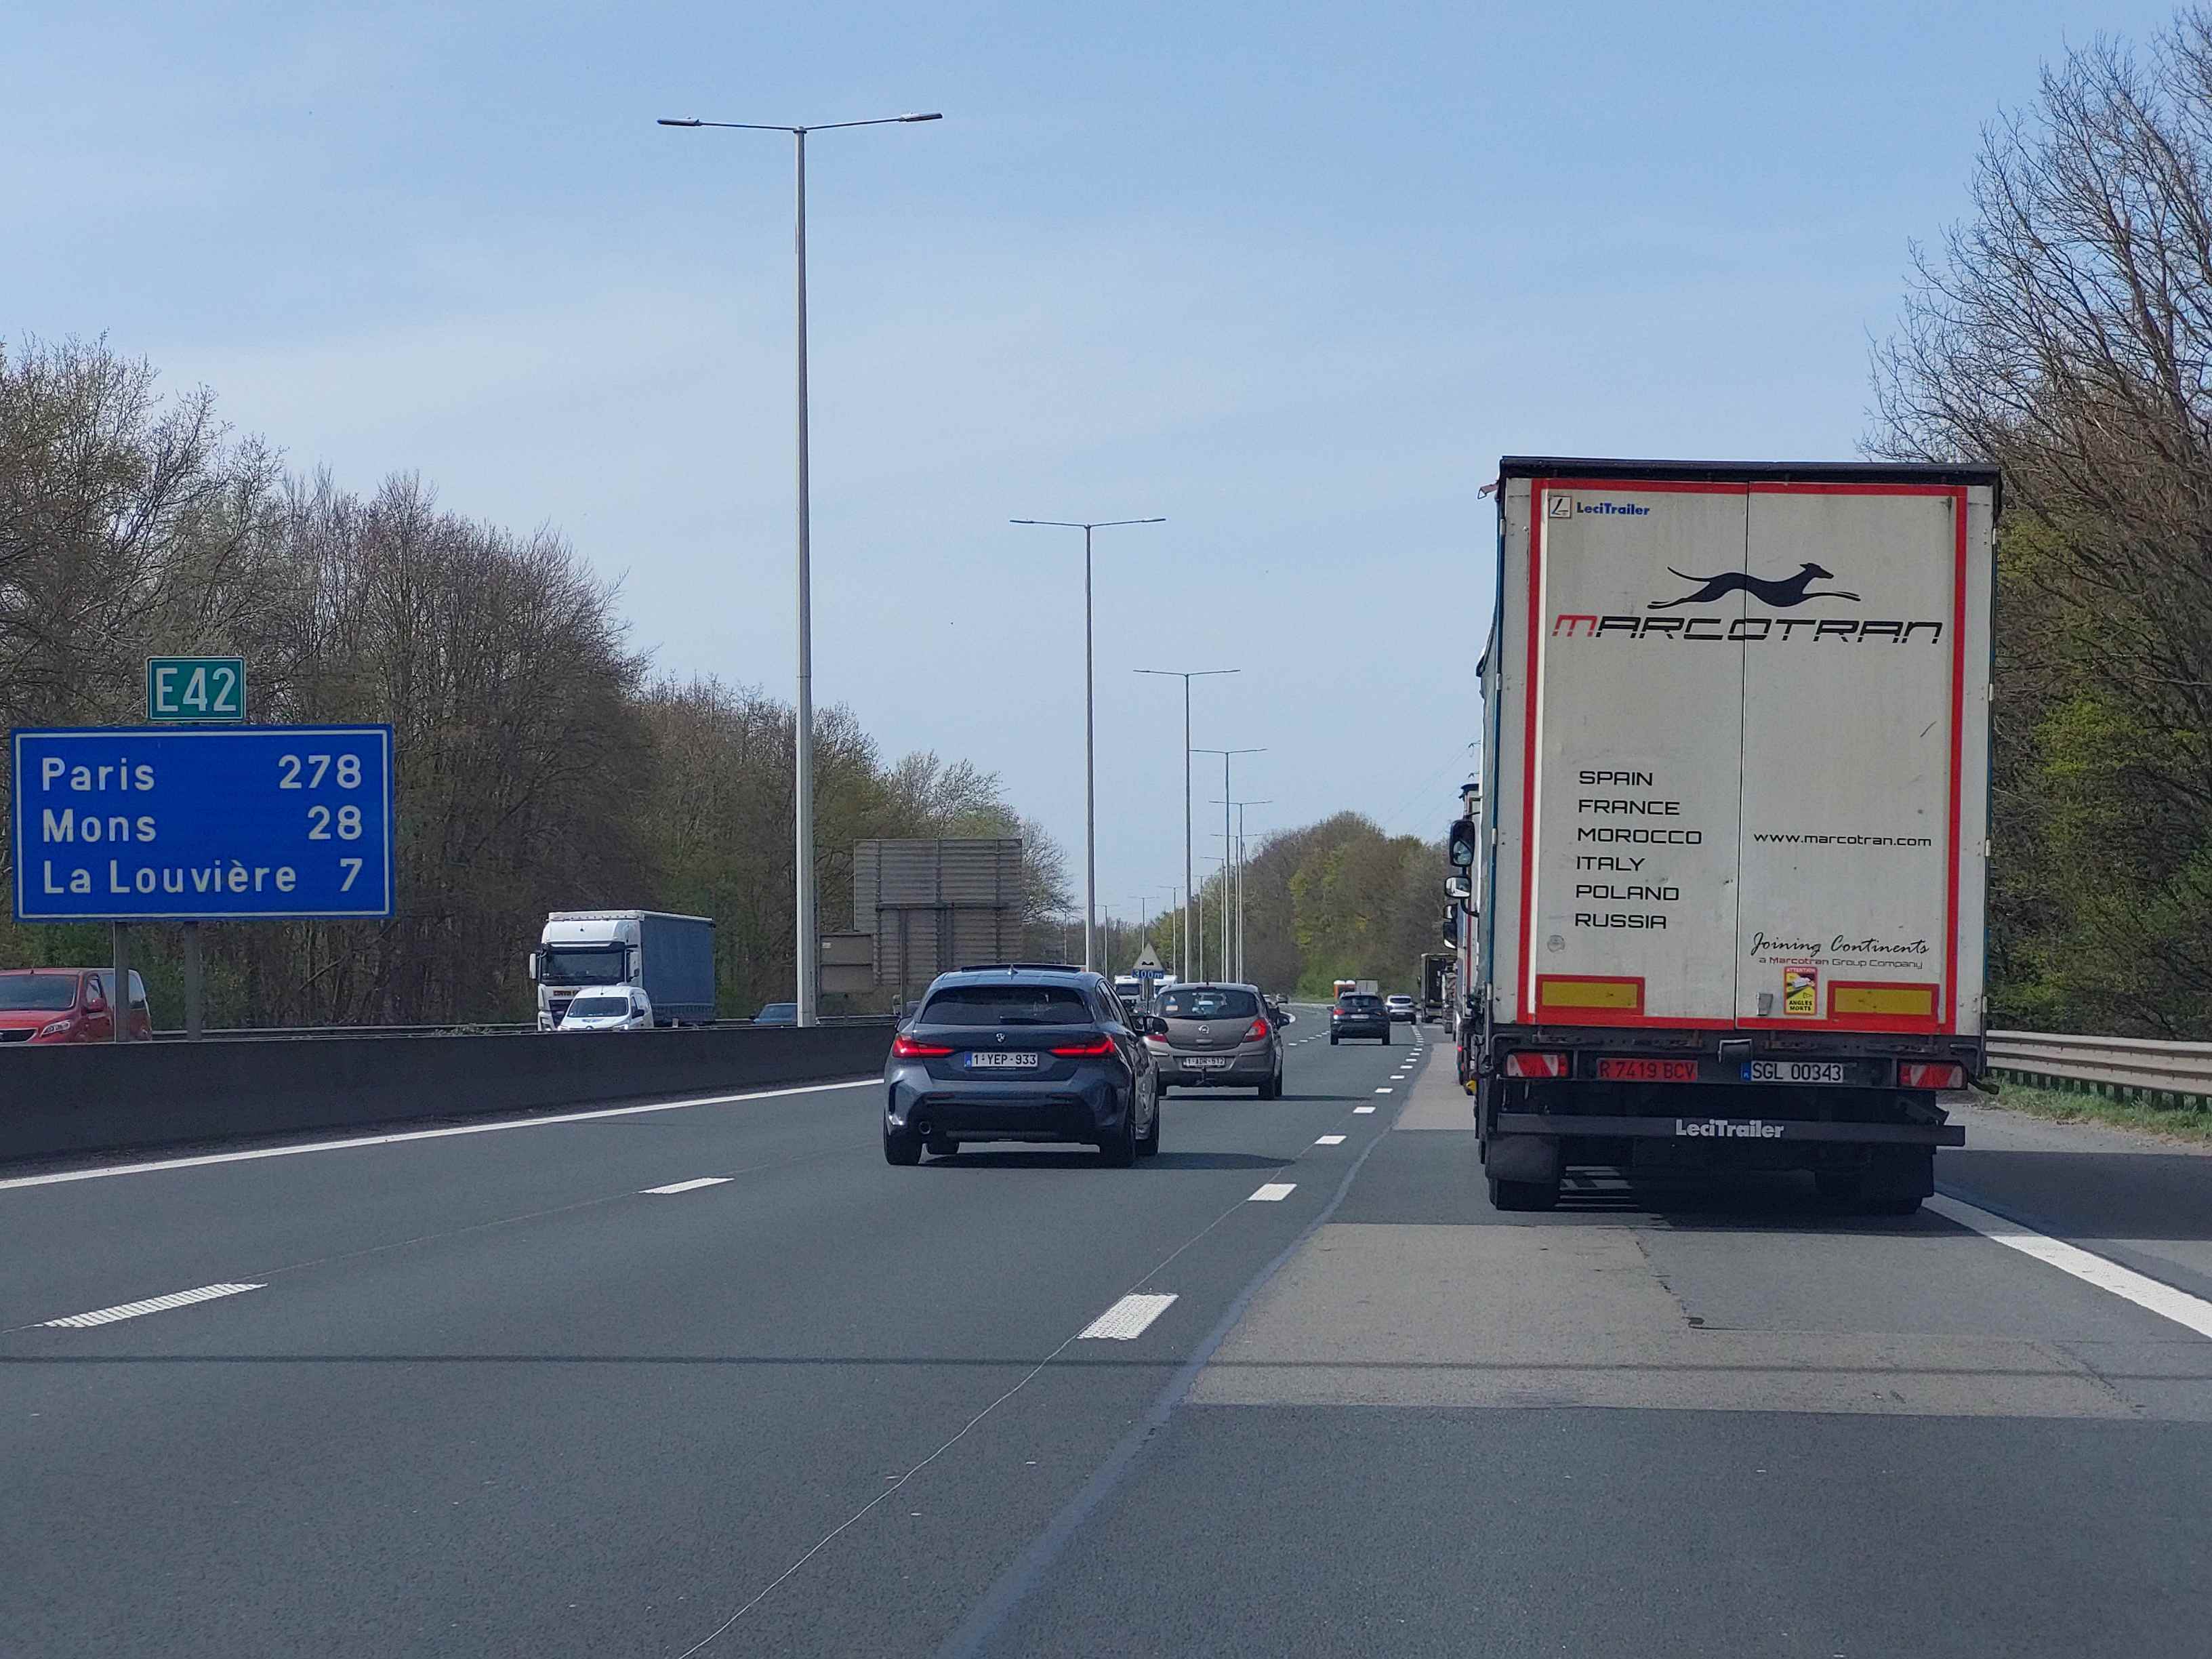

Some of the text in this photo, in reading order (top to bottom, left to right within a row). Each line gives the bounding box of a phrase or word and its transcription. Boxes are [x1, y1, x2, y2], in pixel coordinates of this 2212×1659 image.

[1576, 501, 1650, 516] LeciTrailer
[1551, 614, 1943, 644] MARCOTRAN
[156, 667, 237, 712] E42
[41, 754, 362, 792] Paris 278
[1579, 771, 1654, 786] SPAIN
[1578, 799, 1681, 815] FRANCE
[43, 805, 363, 842] Mons 28
[1577, 827, 1702, 844] MOROCCO
[1753, 833, 1931, 846] www.marcotran.com
[1576, 856, 1646, 872] ITALY
[43, 857, 363, 894] La Louvière 7
[1575, 884, 1679, 901] POLAND
[1574, 913, 1667, 929] RUSSIA
[1750, 932, 1930, 958] Joining Continents
[1769, 956, 1829, 966] Marcotran
[1832, 958, 1867, 968] Group
[1869, 960, 1923, 970] Company
[1599, 1061, 1695, 1079] R 7419 BCV
[1752, 1062, 1784, 1080] SGL
[1790, 1063, 1842, 1082] 00343
[1675, 1118, 1784, 1139] LeciTrailer
